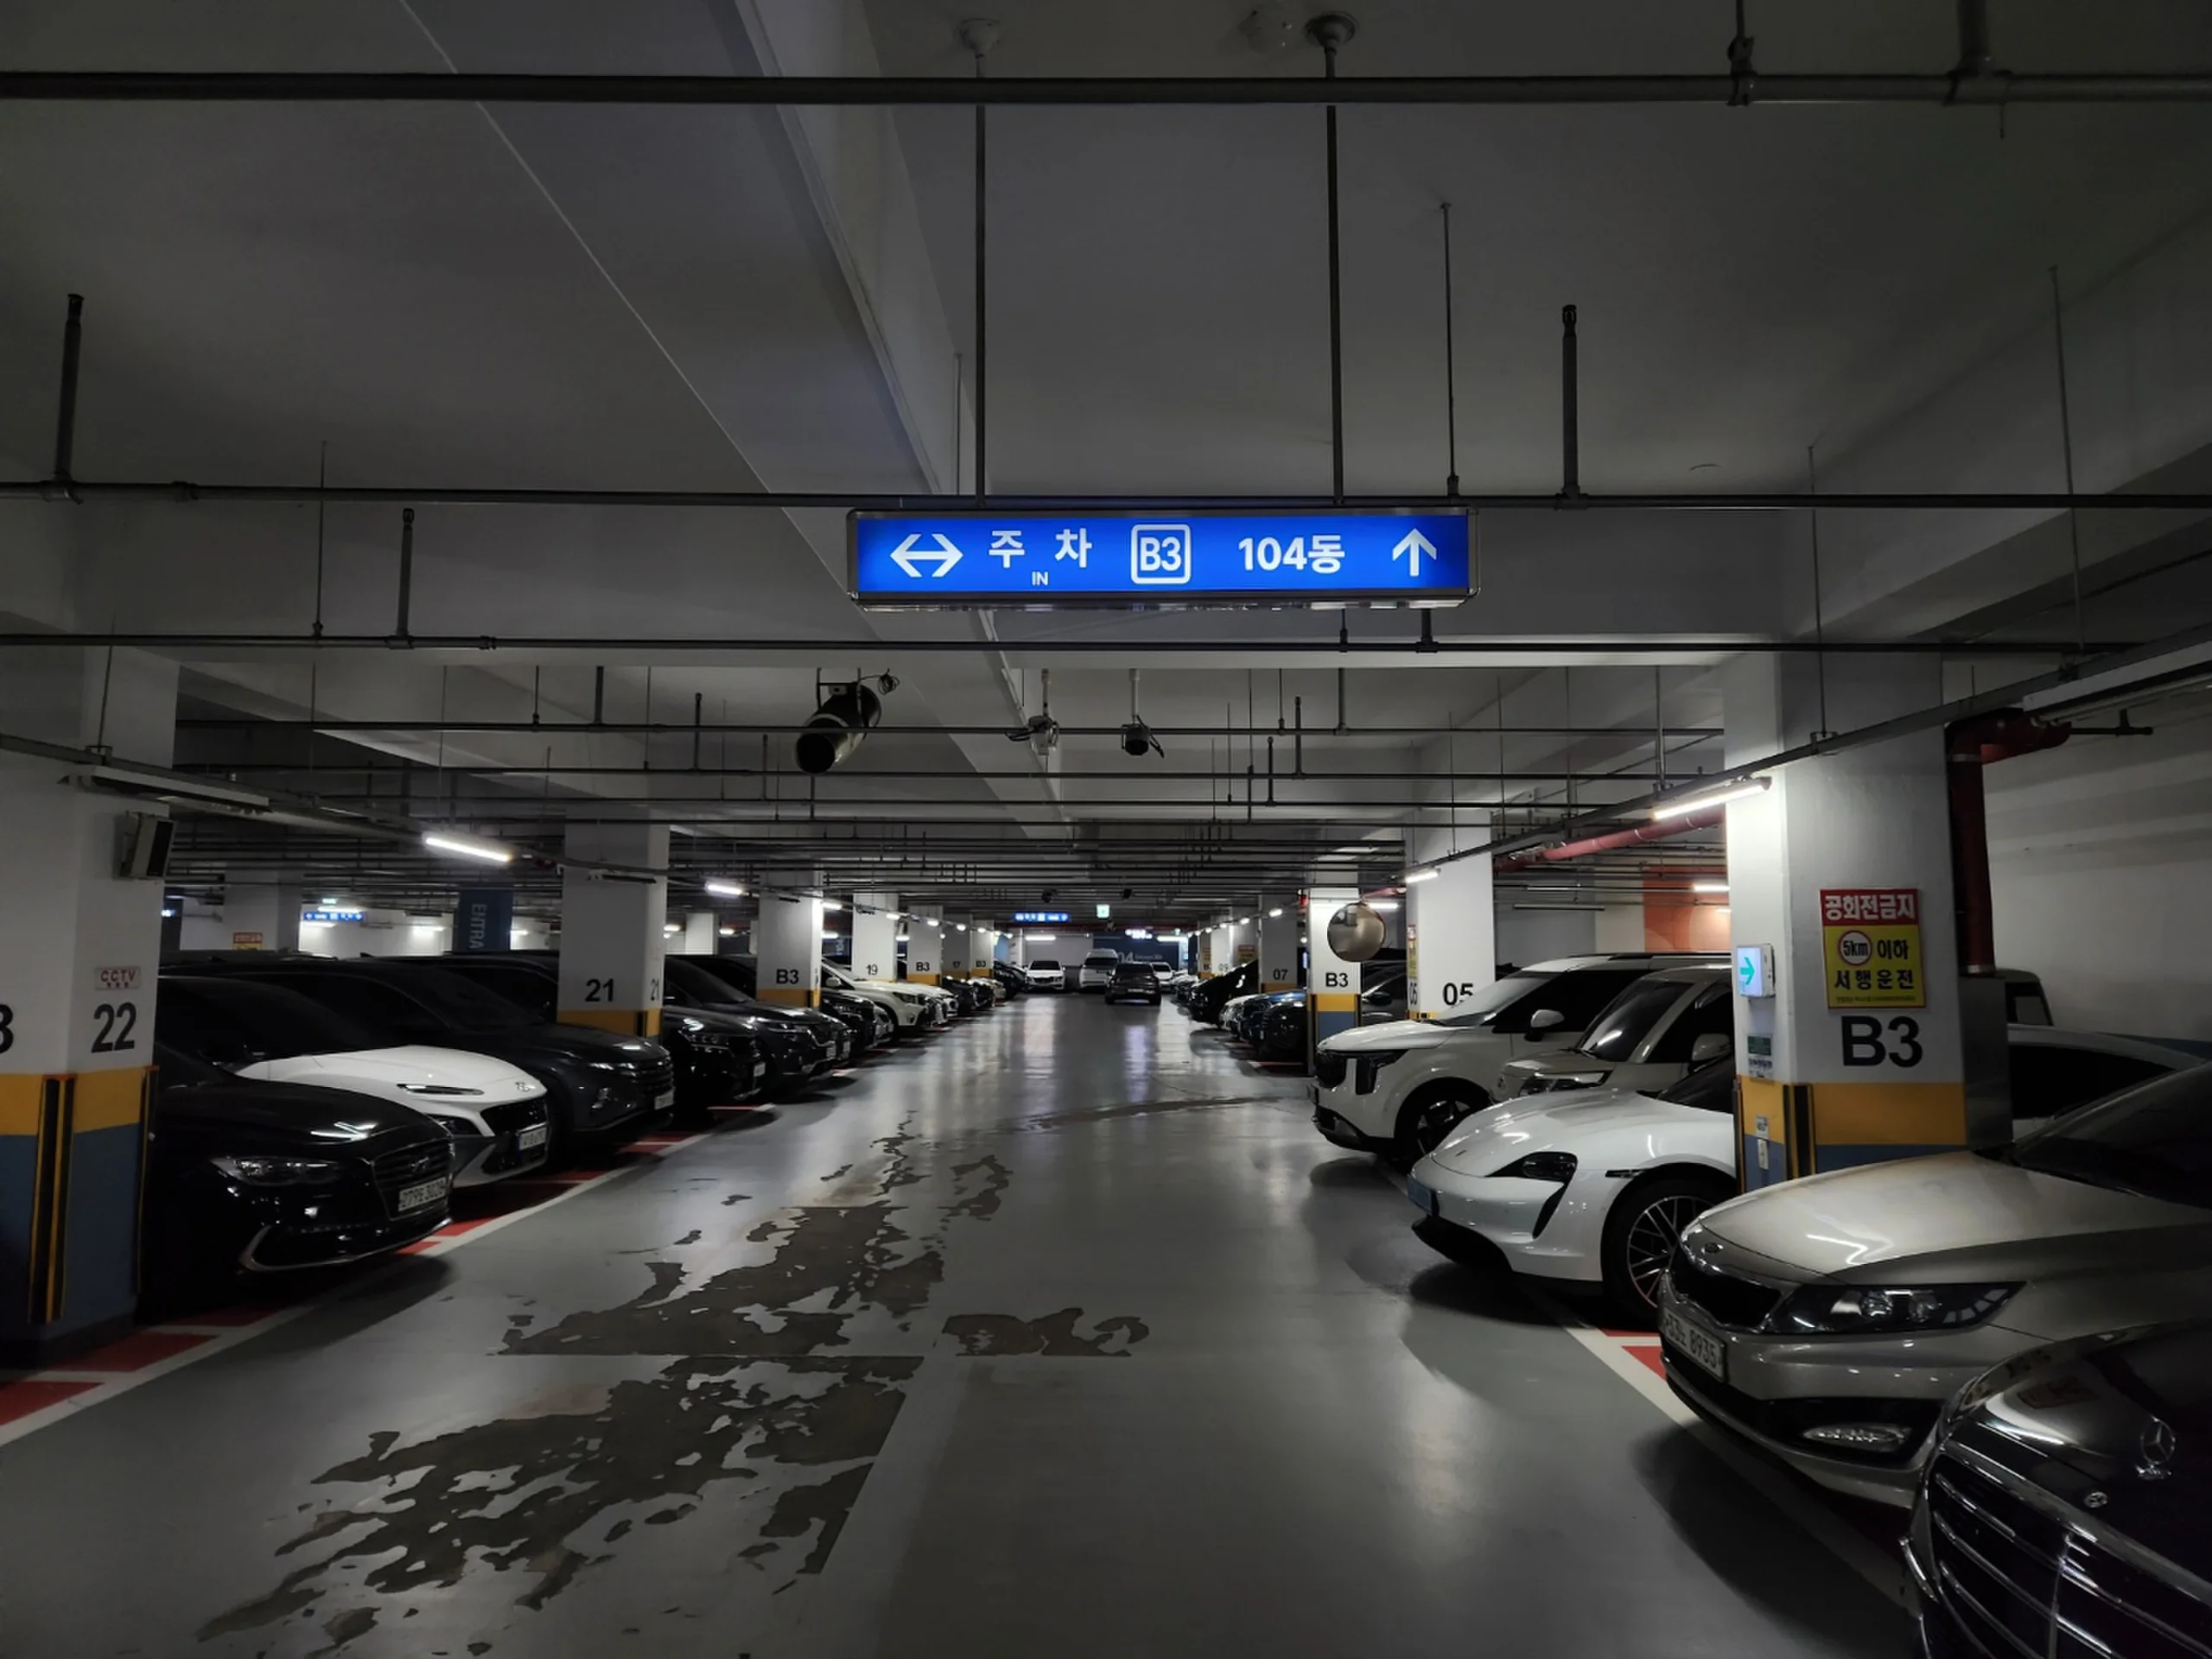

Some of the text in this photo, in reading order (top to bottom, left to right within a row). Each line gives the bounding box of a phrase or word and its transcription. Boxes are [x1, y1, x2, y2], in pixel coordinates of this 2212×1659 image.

[1140, 536, 1182, 572] B3
[1238, 534, 1345, 575] 104동
[1032, 571, 1049, 587] IN
[1824, 893, 1916, 921] 공회전금지
[1842, 939, 1869, 957] 5km
[1876, 938, 1910, 961] 이하
[100, 969, 137, 983] CCTV
[866, 964, 879, 976] 19
[916, 962, 931, 971] B3
[1273, 969, 1289, 981] 07
[776, 969, 799, 985] B3
[1325, 972, 1349, 988] B3
[584, 978, 614, 1002] 21
[1442, 982, 1474, 1007] 05
[91, 1001, 137, 1053] 22
[1840, 1014, 1924, 1068] B3
